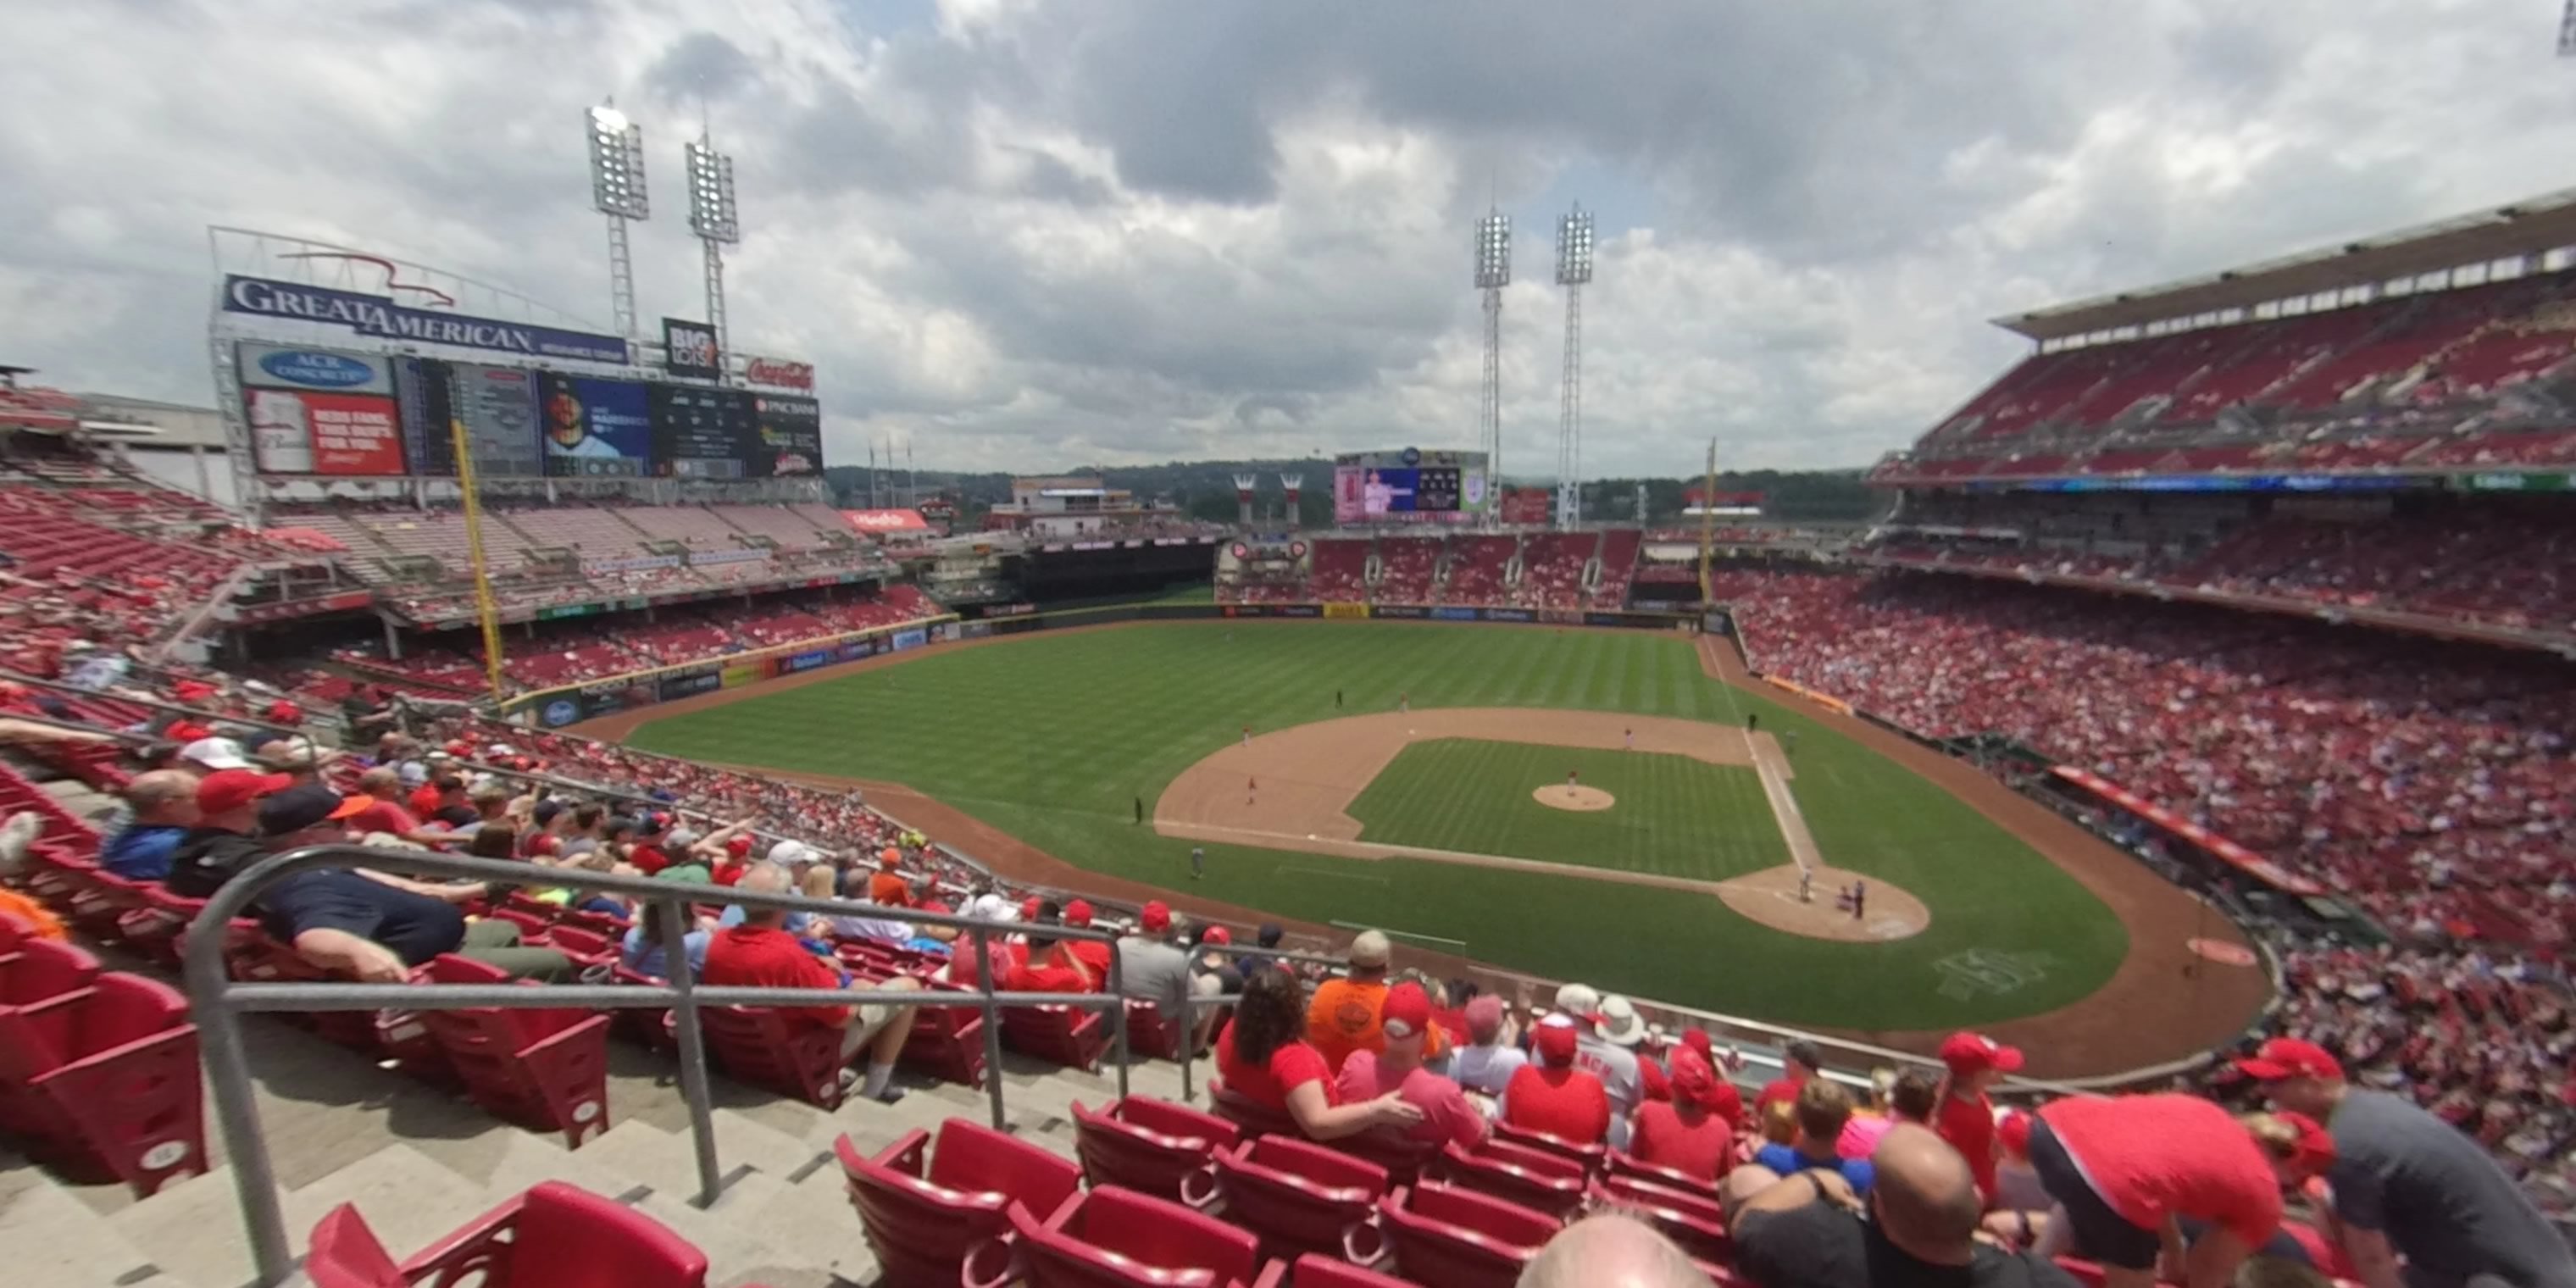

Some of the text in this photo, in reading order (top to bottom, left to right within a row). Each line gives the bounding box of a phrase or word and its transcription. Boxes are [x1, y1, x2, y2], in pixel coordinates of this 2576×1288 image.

[232, 280, 536, 353] GREAT AMERICAN
[669, 326, 711, 348] BIG
[297, 353, 341, 369] ACR
[273, 365, 365, 381] CONCRETE
[316, 423, 349, 436] THIS
[318, 436, 348, 448] FOR
[1580, 1051, 1613, 1078] NCH
